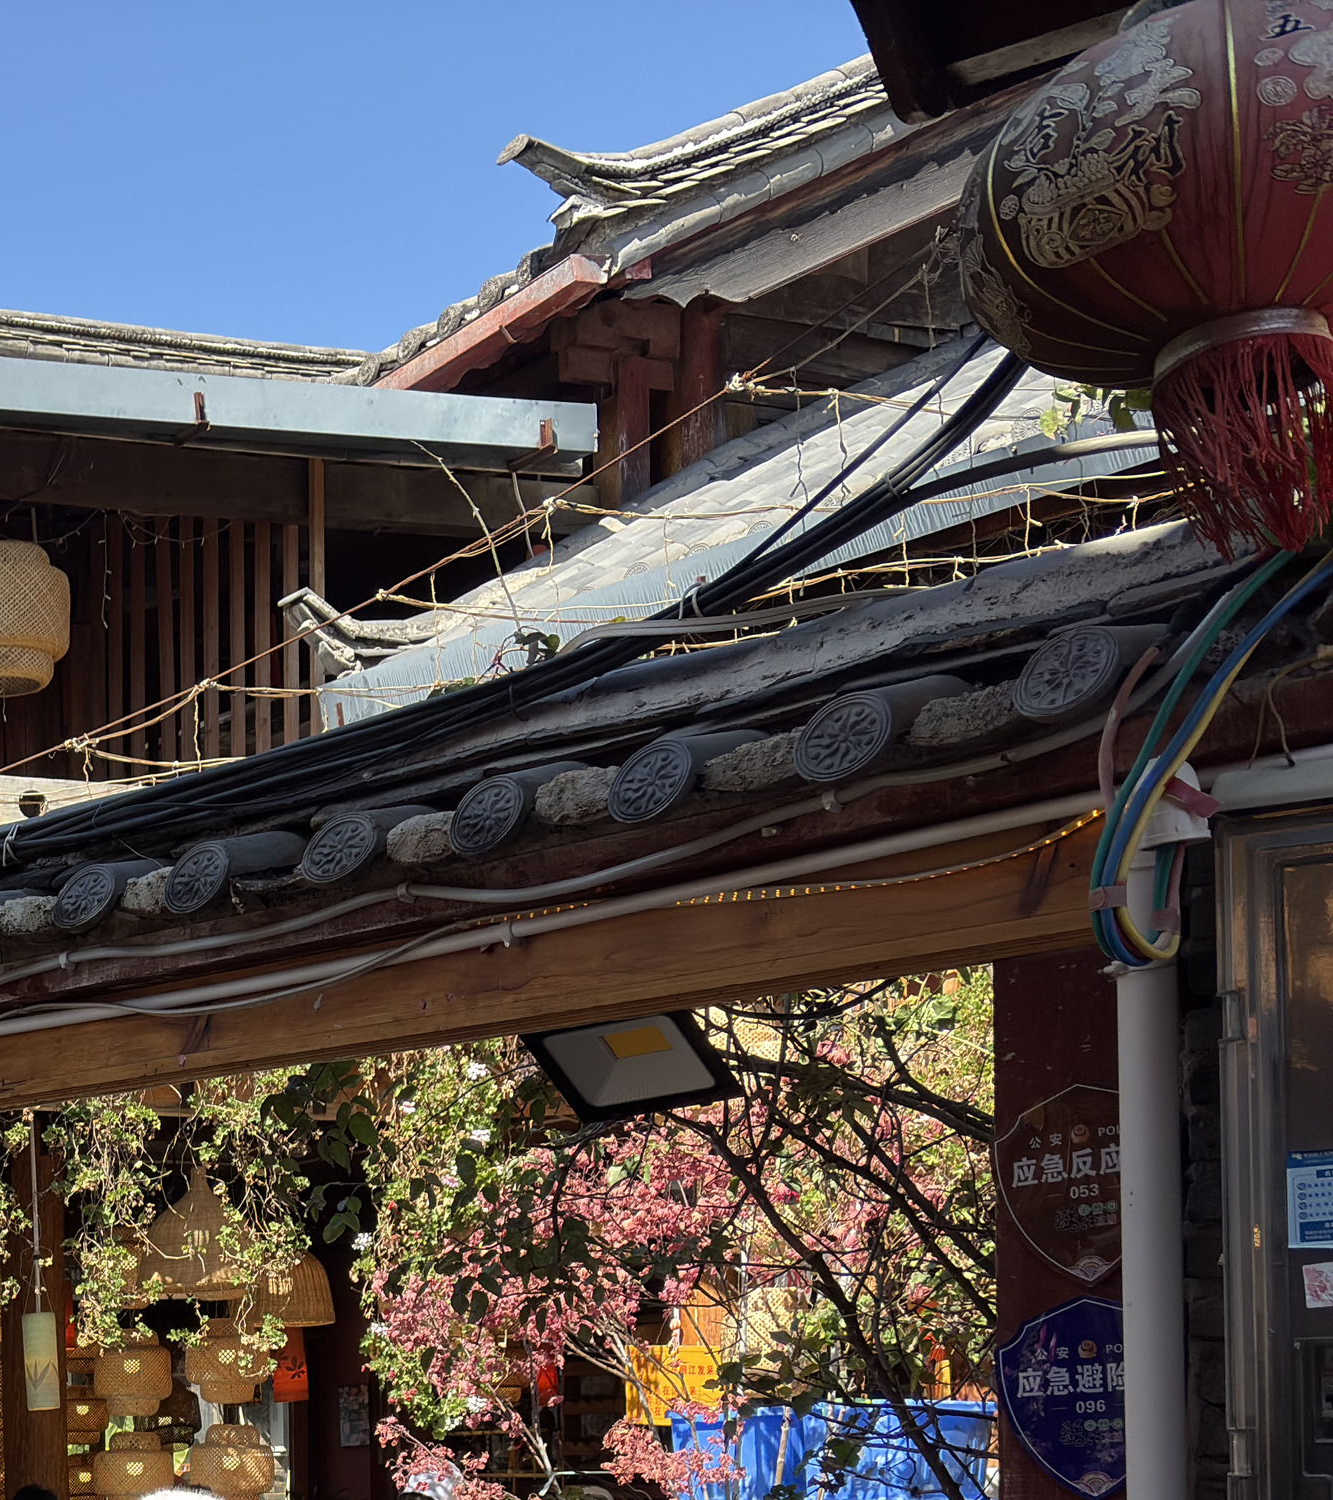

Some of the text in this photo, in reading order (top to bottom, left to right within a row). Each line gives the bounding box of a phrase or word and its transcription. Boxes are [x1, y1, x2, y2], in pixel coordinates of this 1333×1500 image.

[1029, 1132, 1063, 1149] 公安
[1011, 1142, 1121, 1189] 应急反应
[1069, 1183, 1099, 1199] 053
[1035, 1347, 1069, 1360] 公安
[1017, 1361, 1125, 1398] 应急避险
[1076, 1399, 1106, 1414] 096
